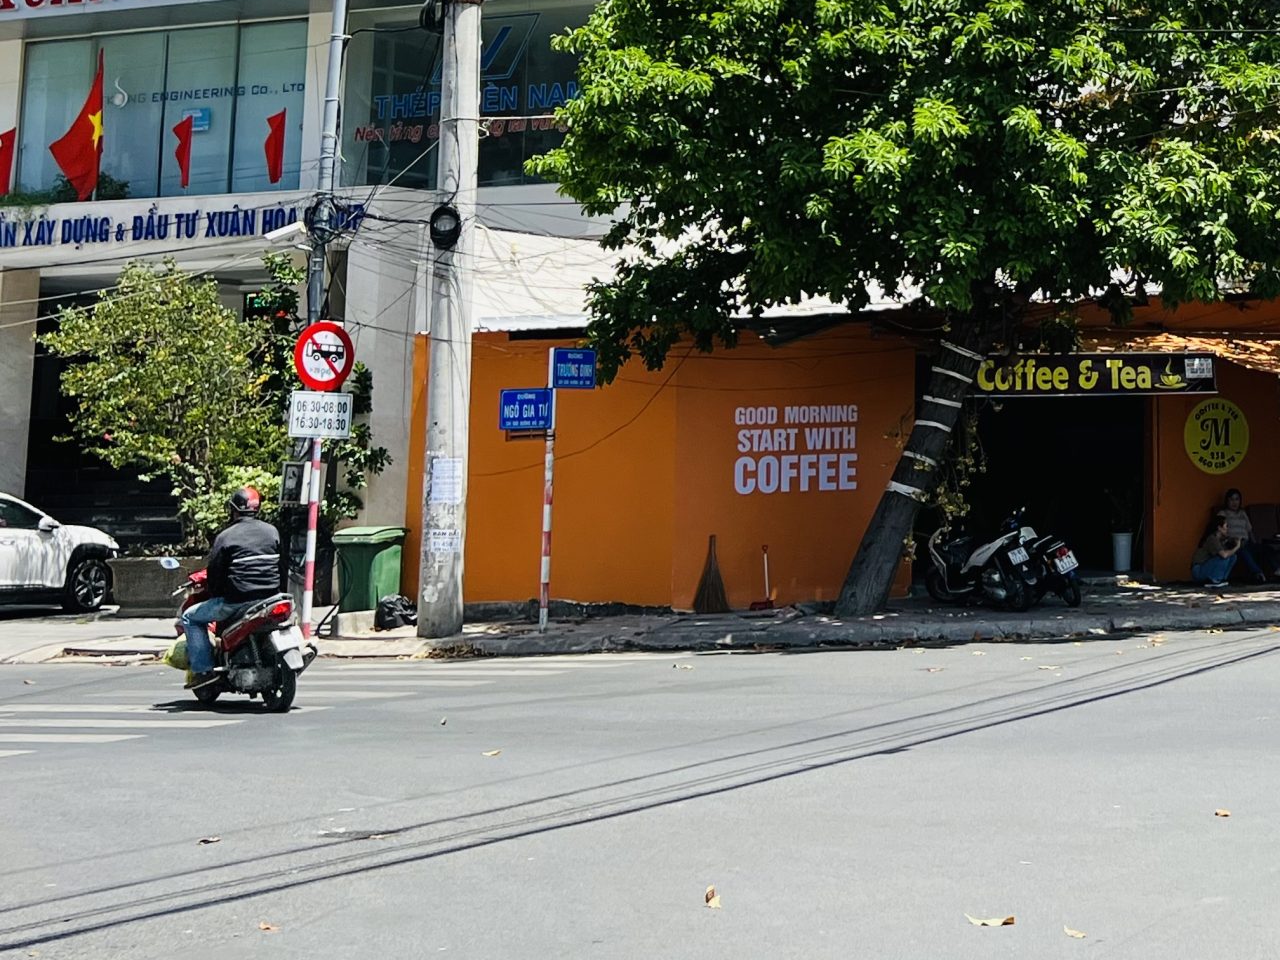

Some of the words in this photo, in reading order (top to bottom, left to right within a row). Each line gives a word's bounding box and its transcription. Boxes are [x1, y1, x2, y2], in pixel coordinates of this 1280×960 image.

[152, 86, 245, 103] ENGINEERING
[22, 214, 56, 246] XÂY
[61, 215, 110, 250] DỰNG
[115, 223, 125, 242] &
[132, 202, 169, 240] ĐẦU
[175, 209, 200, 239] TƯ
[205, 204, 255, 238] XUÂN
[977, 358, 1070, 391] Coffee
[1078, 359, 1099, 390] &
[1106, 359, 1152, 390] Tea
[296, 400, 348, 415] 06:30-08:00
[504, 401, 519, 419] NGÔ
[522, 404, 535, 418] GIA
[734, 406, 778, 425] GOOD
[784, 404, 859, 424] MORNING
[295, 415, 347, 431] 16:30-18:30
[1200, 417, 1231, 451] M
[737, 427, 799, 453] START
[804, 426, 857, 450] WITH
[734, 453, 858, 495] COFFEE
